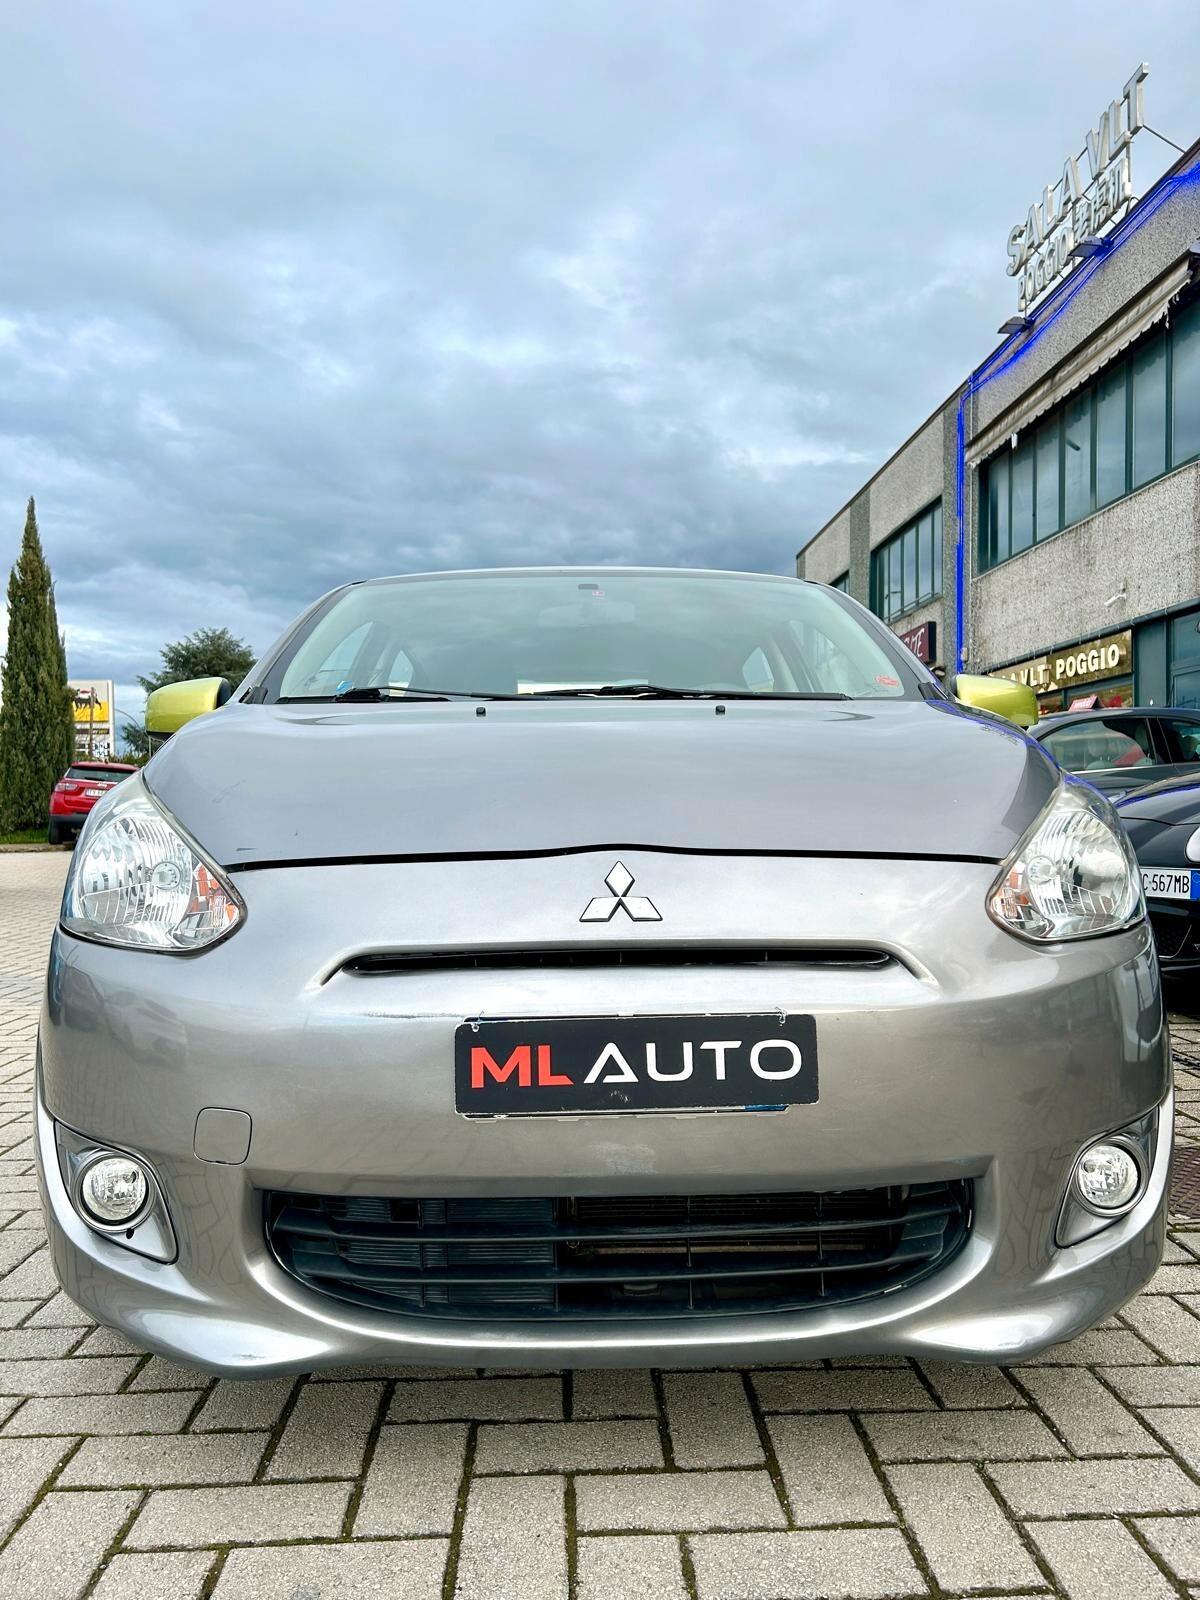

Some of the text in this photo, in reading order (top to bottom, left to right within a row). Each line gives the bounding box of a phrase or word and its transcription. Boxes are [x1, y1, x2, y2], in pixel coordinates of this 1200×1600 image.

[1007, 62, 1149, 276] SALA VLT
[1018, 227, 1075, 312] POGGIO
[1056, 644, 1120, 680] POGGIO
[471, 1039, 803, 1089] ML AUTO
